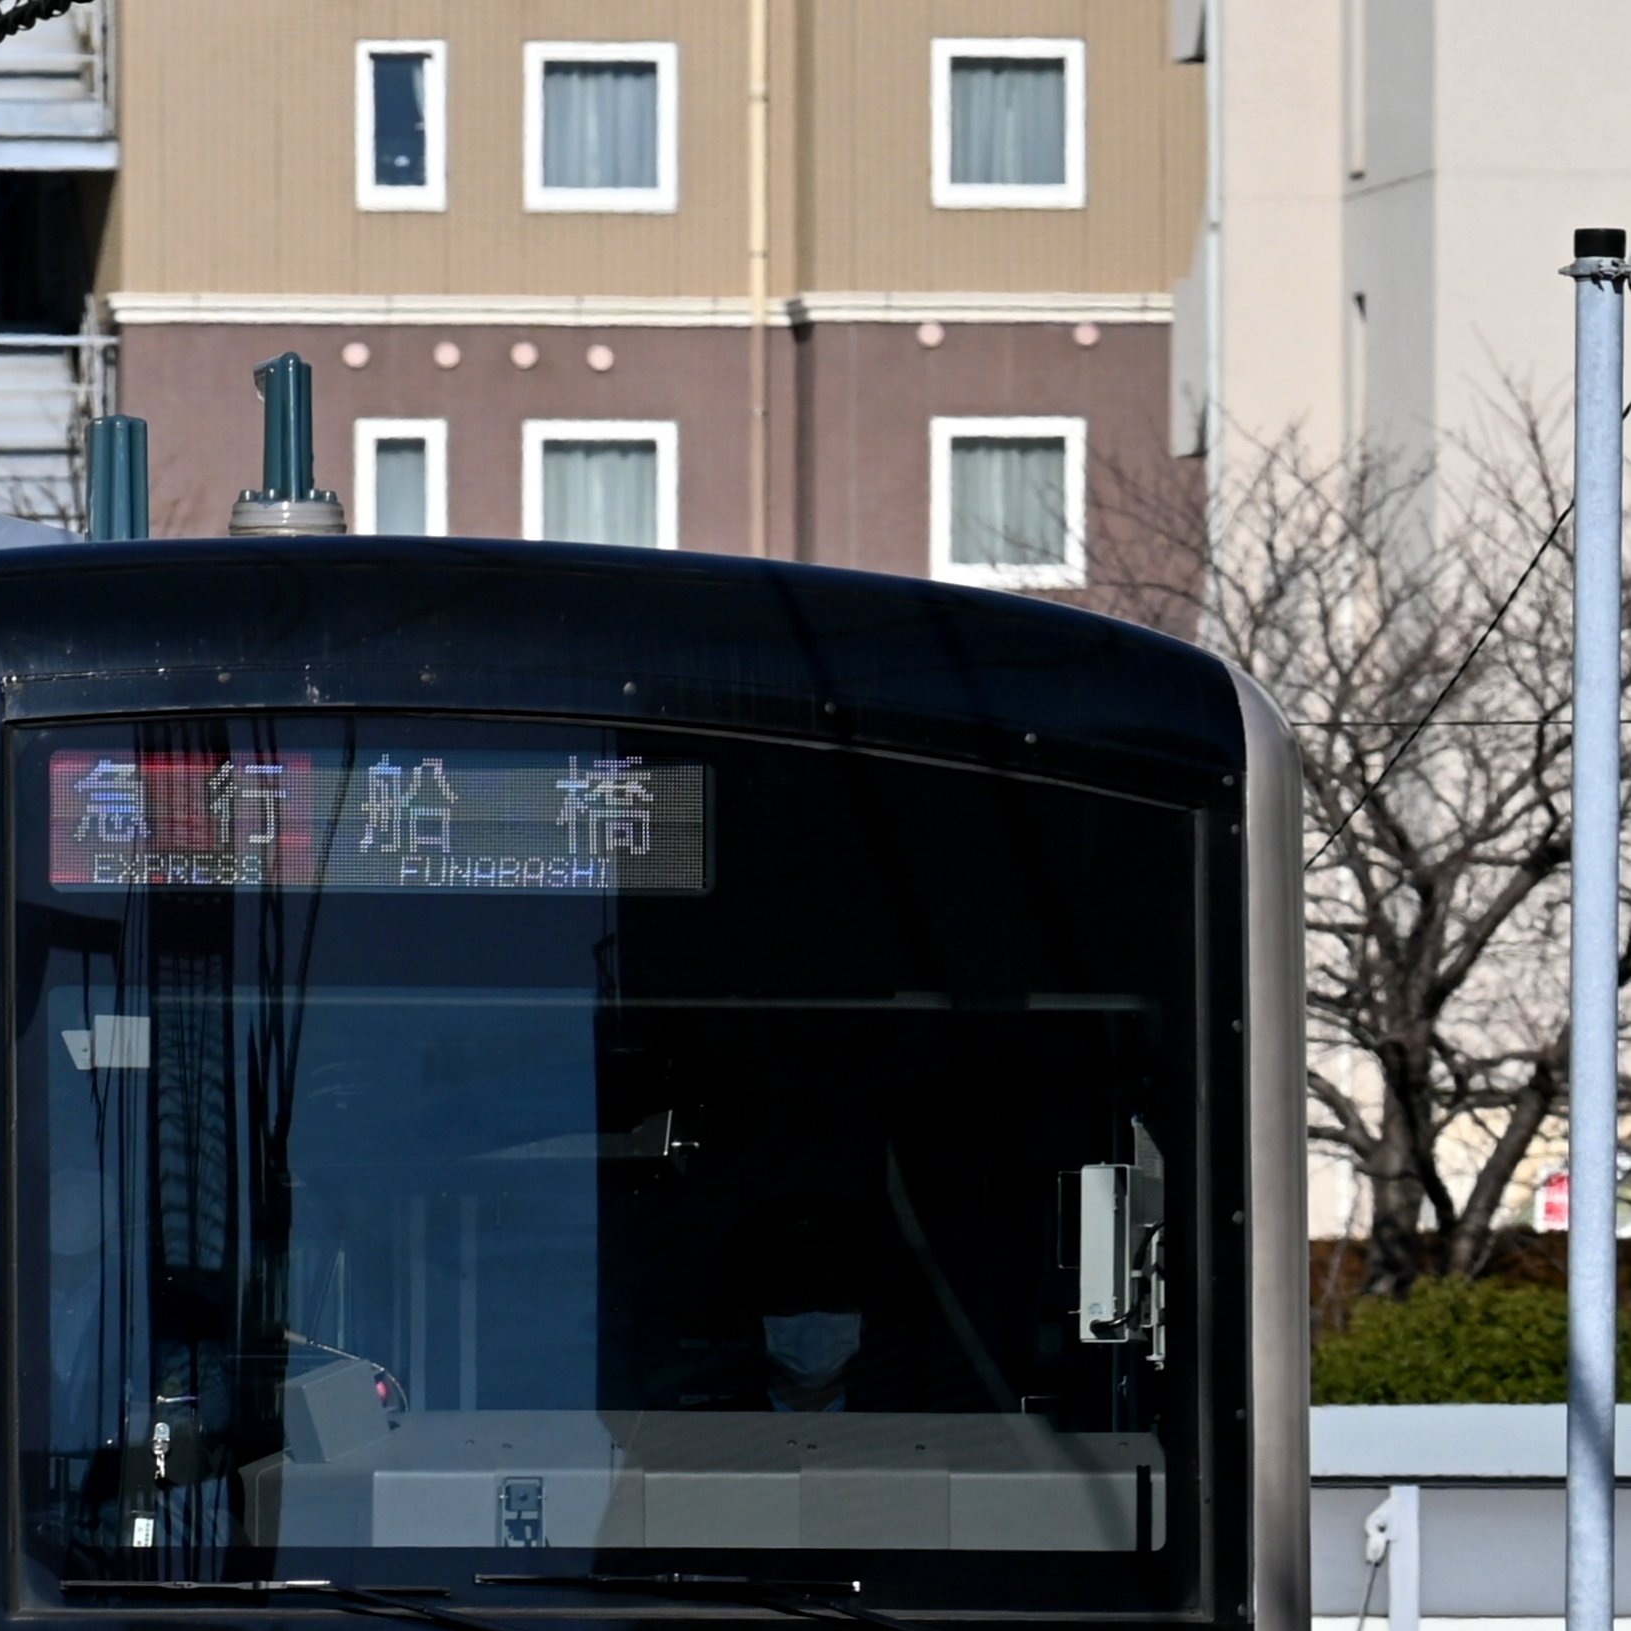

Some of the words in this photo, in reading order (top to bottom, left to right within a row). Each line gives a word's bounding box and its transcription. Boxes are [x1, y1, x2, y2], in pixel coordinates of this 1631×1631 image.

[72, 757, 289, 845] 急行
[359, 753, 657, 855] 船橋
[91, 853, 265, 885] EXPRESS
[398, 854, 613, 889] FUNABASHI
